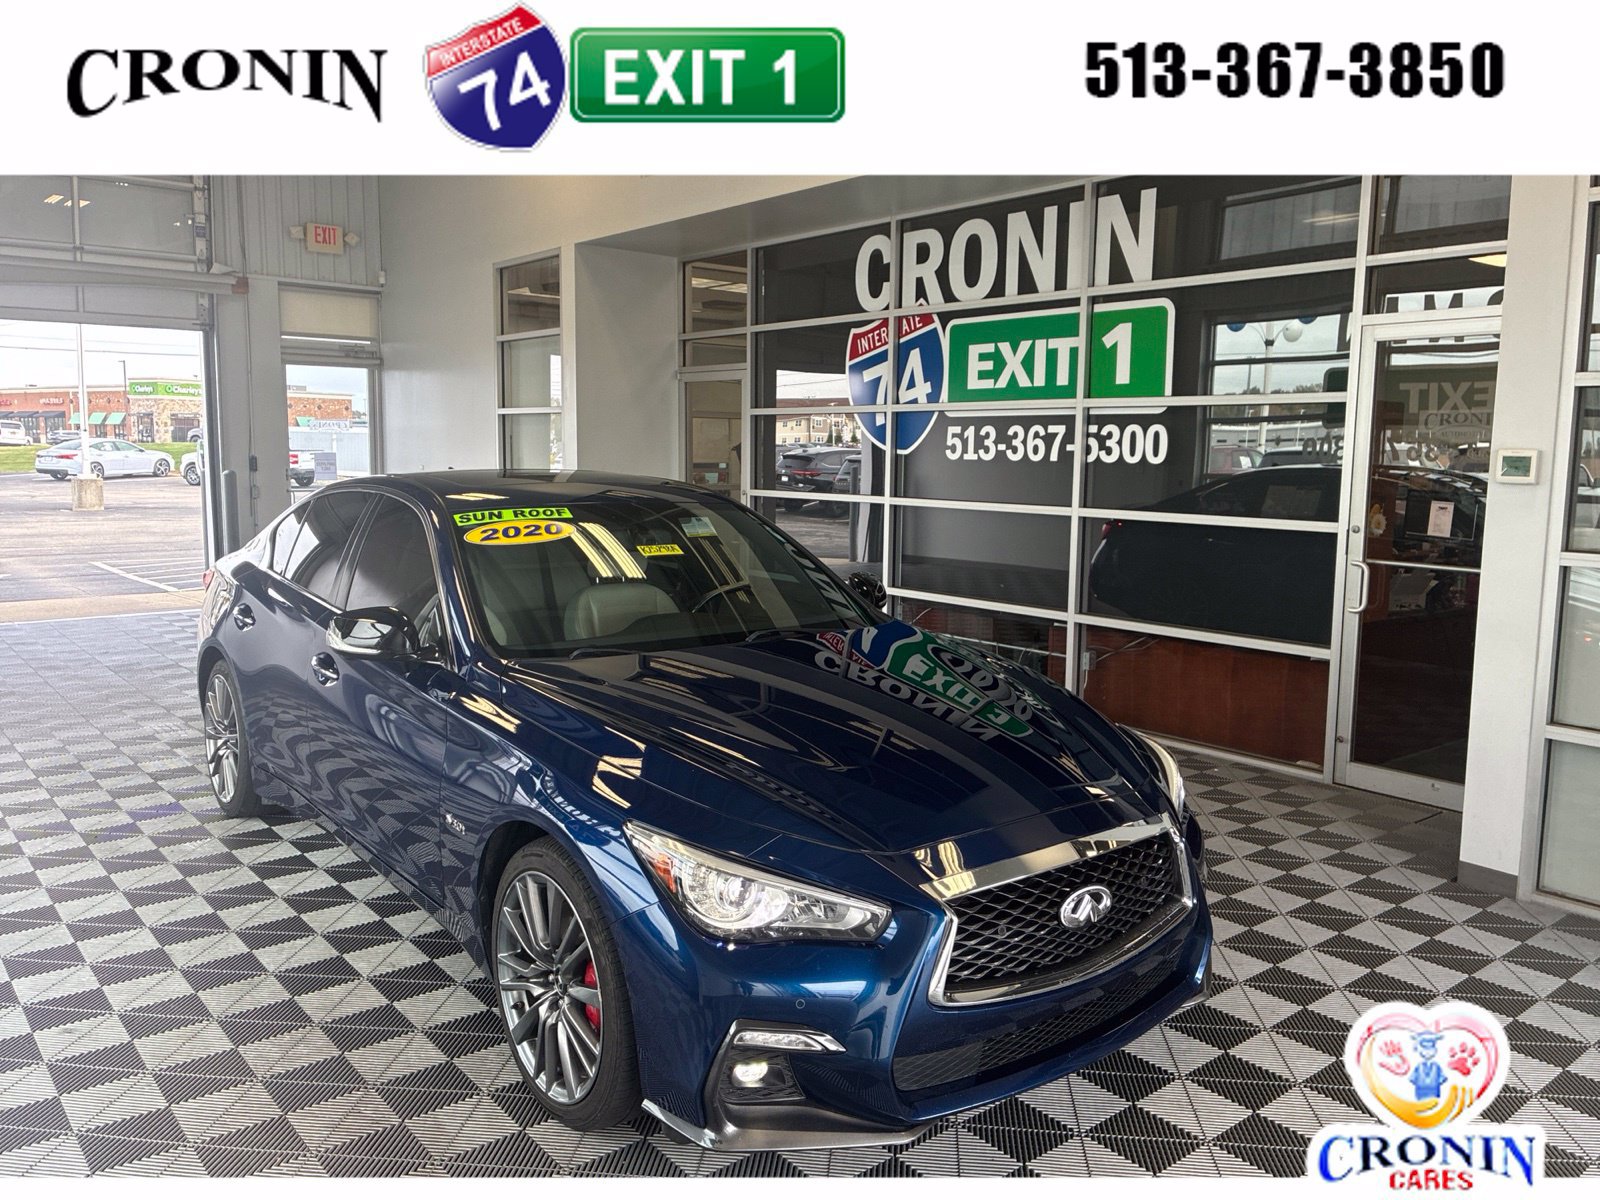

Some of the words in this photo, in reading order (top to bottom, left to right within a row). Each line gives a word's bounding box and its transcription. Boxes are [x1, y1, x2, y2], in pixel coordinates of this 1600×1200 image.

[313, 225, 338, 247] EXIT
[855, 187, 1158, 313] CRONIN
[857, 315, 924, 355] INTERATE
[967, 336, 1080, 390] EXIT
[1102, 322, 1132, 385] 1
[862, 347, 932, 427] 74
[945, 423, 1168, 464] 513-367-5300
[458, 510, 504, 524] SUN
[513, 507, 568, 519] ROOF
[480, 523, 562, 541] 2020
